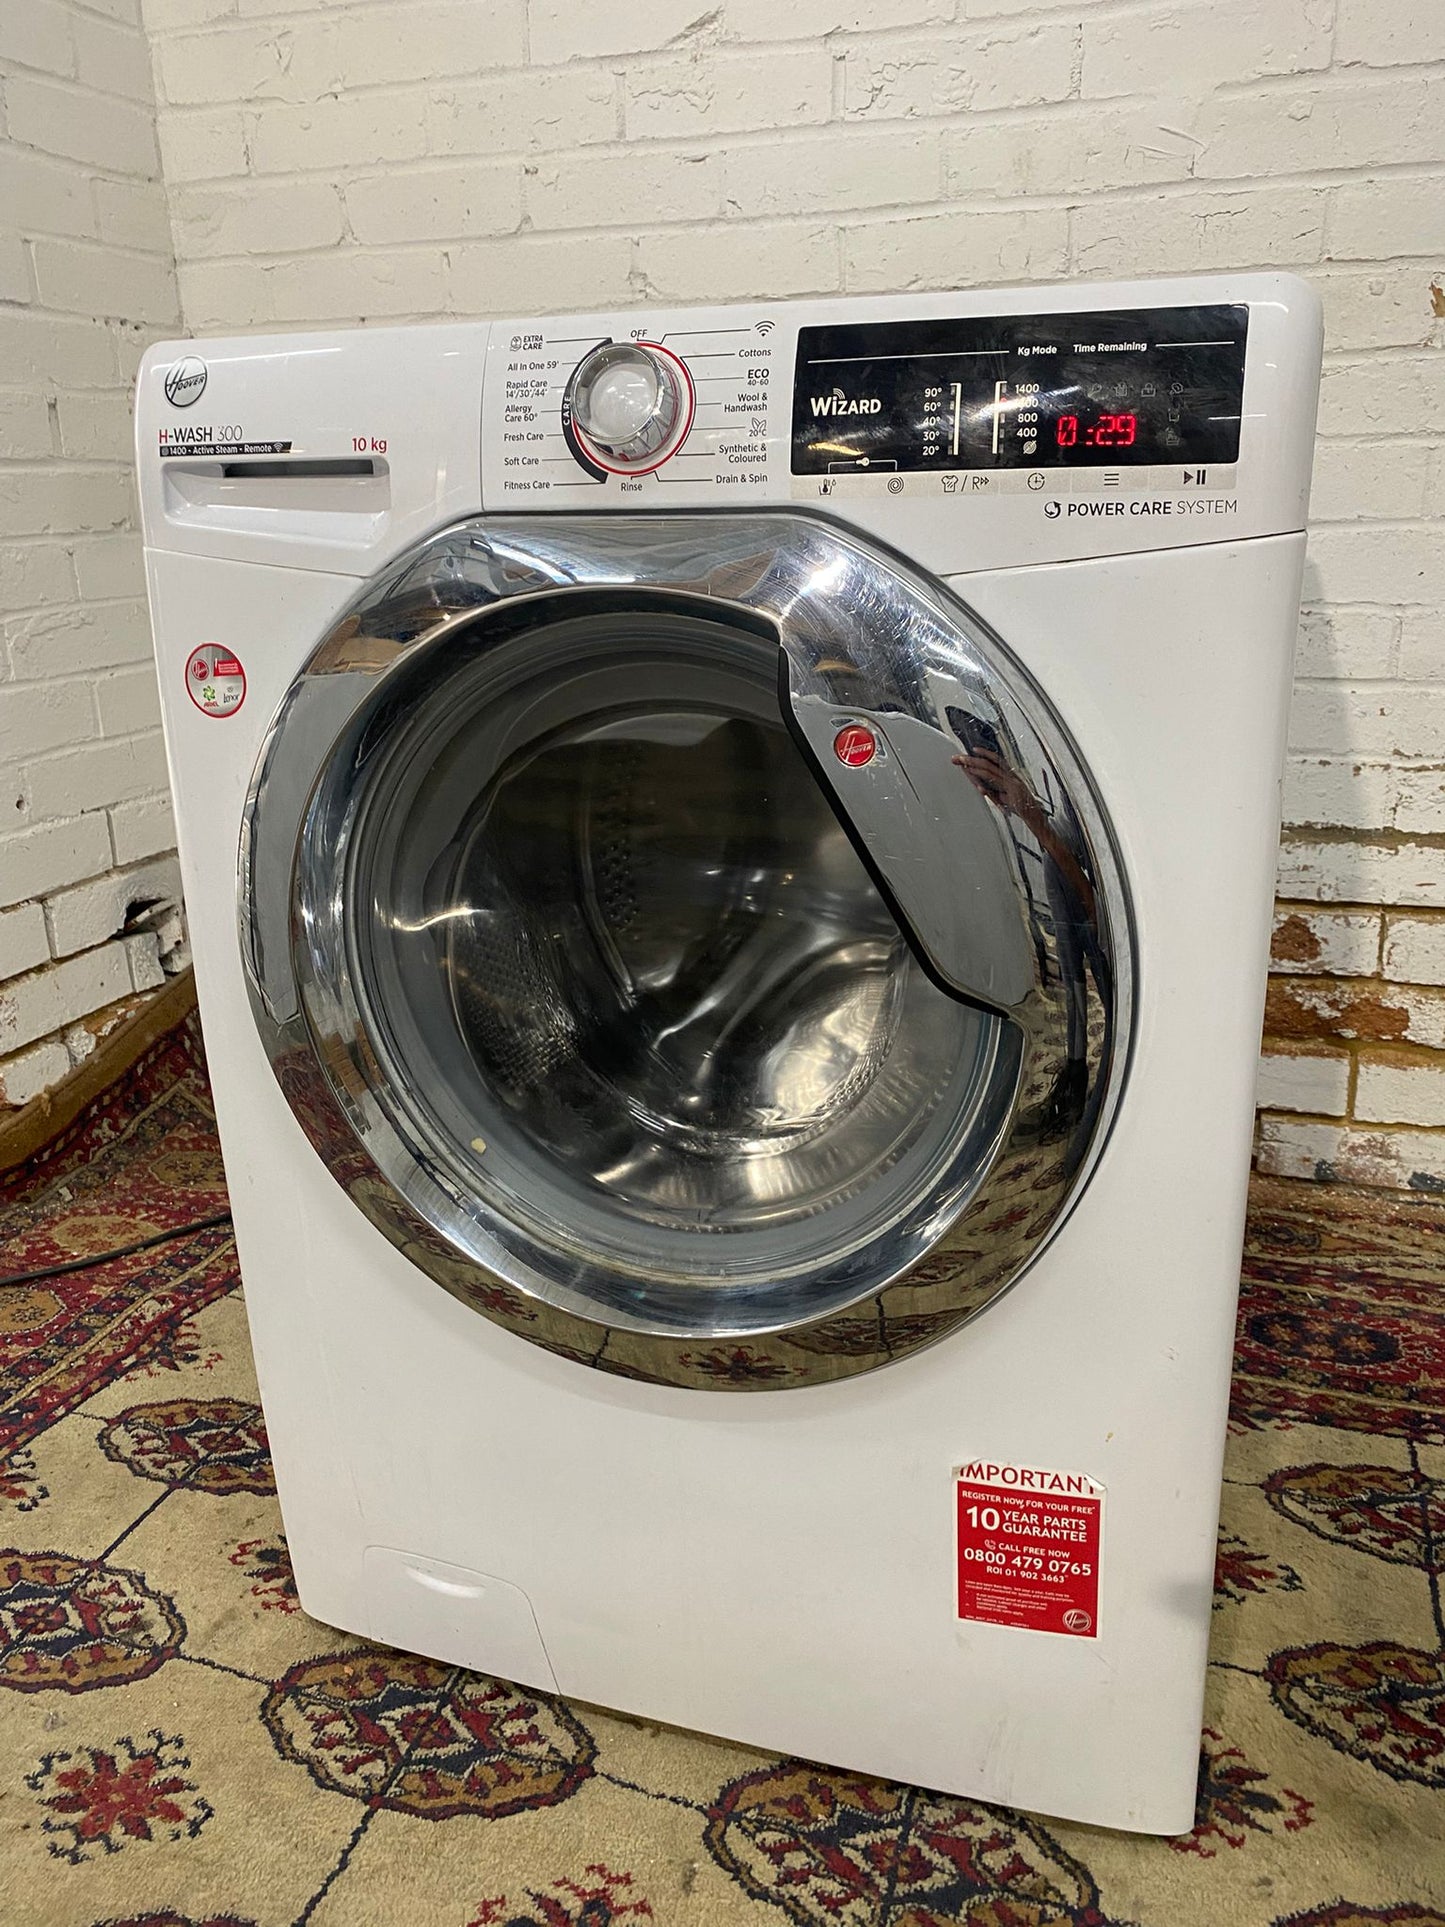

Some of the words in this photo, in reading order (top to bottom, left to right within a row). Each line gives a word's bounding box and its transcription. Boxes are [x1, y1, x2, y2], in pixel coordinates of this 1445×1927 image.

[630, 329, 647, 338] OFF
[1017, 347, 1030, 357] Kg
[1032, 345, 1057, 355] Mode
[1073, 343, 1096, 353] Time
[1098, 341, 1147, 352] Remaining
[739, 349, 772, 357] Cottons
[507, 363, 518, 371] All
[519, 363, 527, 371] In
[529, 362, 545, 370] One
[748, 368, 770, 379] ECO
[506, 381, 529, 390] Rapid
[530, 380, 548, 388] Care
[1015, 384, 1039, 394] 1400
[738, 393, 759, 402] Wool
[761, 392, 768, 401] &
[924, 387, 942, 398] 90°
[505, 405, 532, 414] Allergy
[563, 396, 571, 425] CARE
[724, 403, 768, 413] Handwash
[923, 401, 941, 412] 60°
[504, 414, 522, 423] Care
[1017, 412, 1038, 423] 800
[159, 426, 213, 443] H-WASH
[217, 425, 243, 441] 300
[504, 433, 525, 442] Fresh
[526, 432, 544, 441] Care
[923, 431, 940, 441] 30°
[1016, 427, 1038, 438] 400
[170, 446, 186, 455] 1400
[193, 445, 215, 455] Active
[215, 445, 238, 454] Steam
[244, 444, 272, 453] Remote
[351, 437, 367, 452] 10
[371, 437, 388, 453] kg
[719, 444, 758, 454] Synthetic
[760, 443, 767, 452] &
[922, 445, 940, 456] 20°
[504, 457, 519, 466] Soft
[522, 457, 539, 465] Care
[729, 453, 767, 463] Coloured
[716, 474, 738, 484] Drain
[740, 474, 747, 483] &
[749, 473, 768, 484] Spin
[504, 481, 531, 490] Fitness
[533, 481, 550, 489] Care
[621, 482, 642, 492] Rinse
[1068, 502, 1125, 517] POWER
[1129, 501, 1172, 515] CARE
[1177, 499, 1238, 514] SYSTEM
[962, 1490, 1001, 1503] REGISTER
[1026, 1500, 1043, 1509] FOR
[1045, 1502, 1069, 1513] YOUR
[966, 1505, 999, 1531] 10
[1002, 1509, 1039, 1525] YEAR
[1043, 1516, 1086, 1530] PARTS
[1002, 1522, 1087, 1543] GUARANTEE
[998, 1542, 1021, 1553] CALL
[1023, 1546, 1045, 1556] FREE
[1048, 1549, 1070, 1559] NOW
[964, 1548, 1006, 1565] 0800
[1011, 1555, 1043, 1570] 479
[1048, 1559, 1091, 1576] 0765
[986, 1566, 1003, 1575] ROI
[1005, 1568, 1017, 1577] 01
[1020, 1571, 1038, 1580] 902
